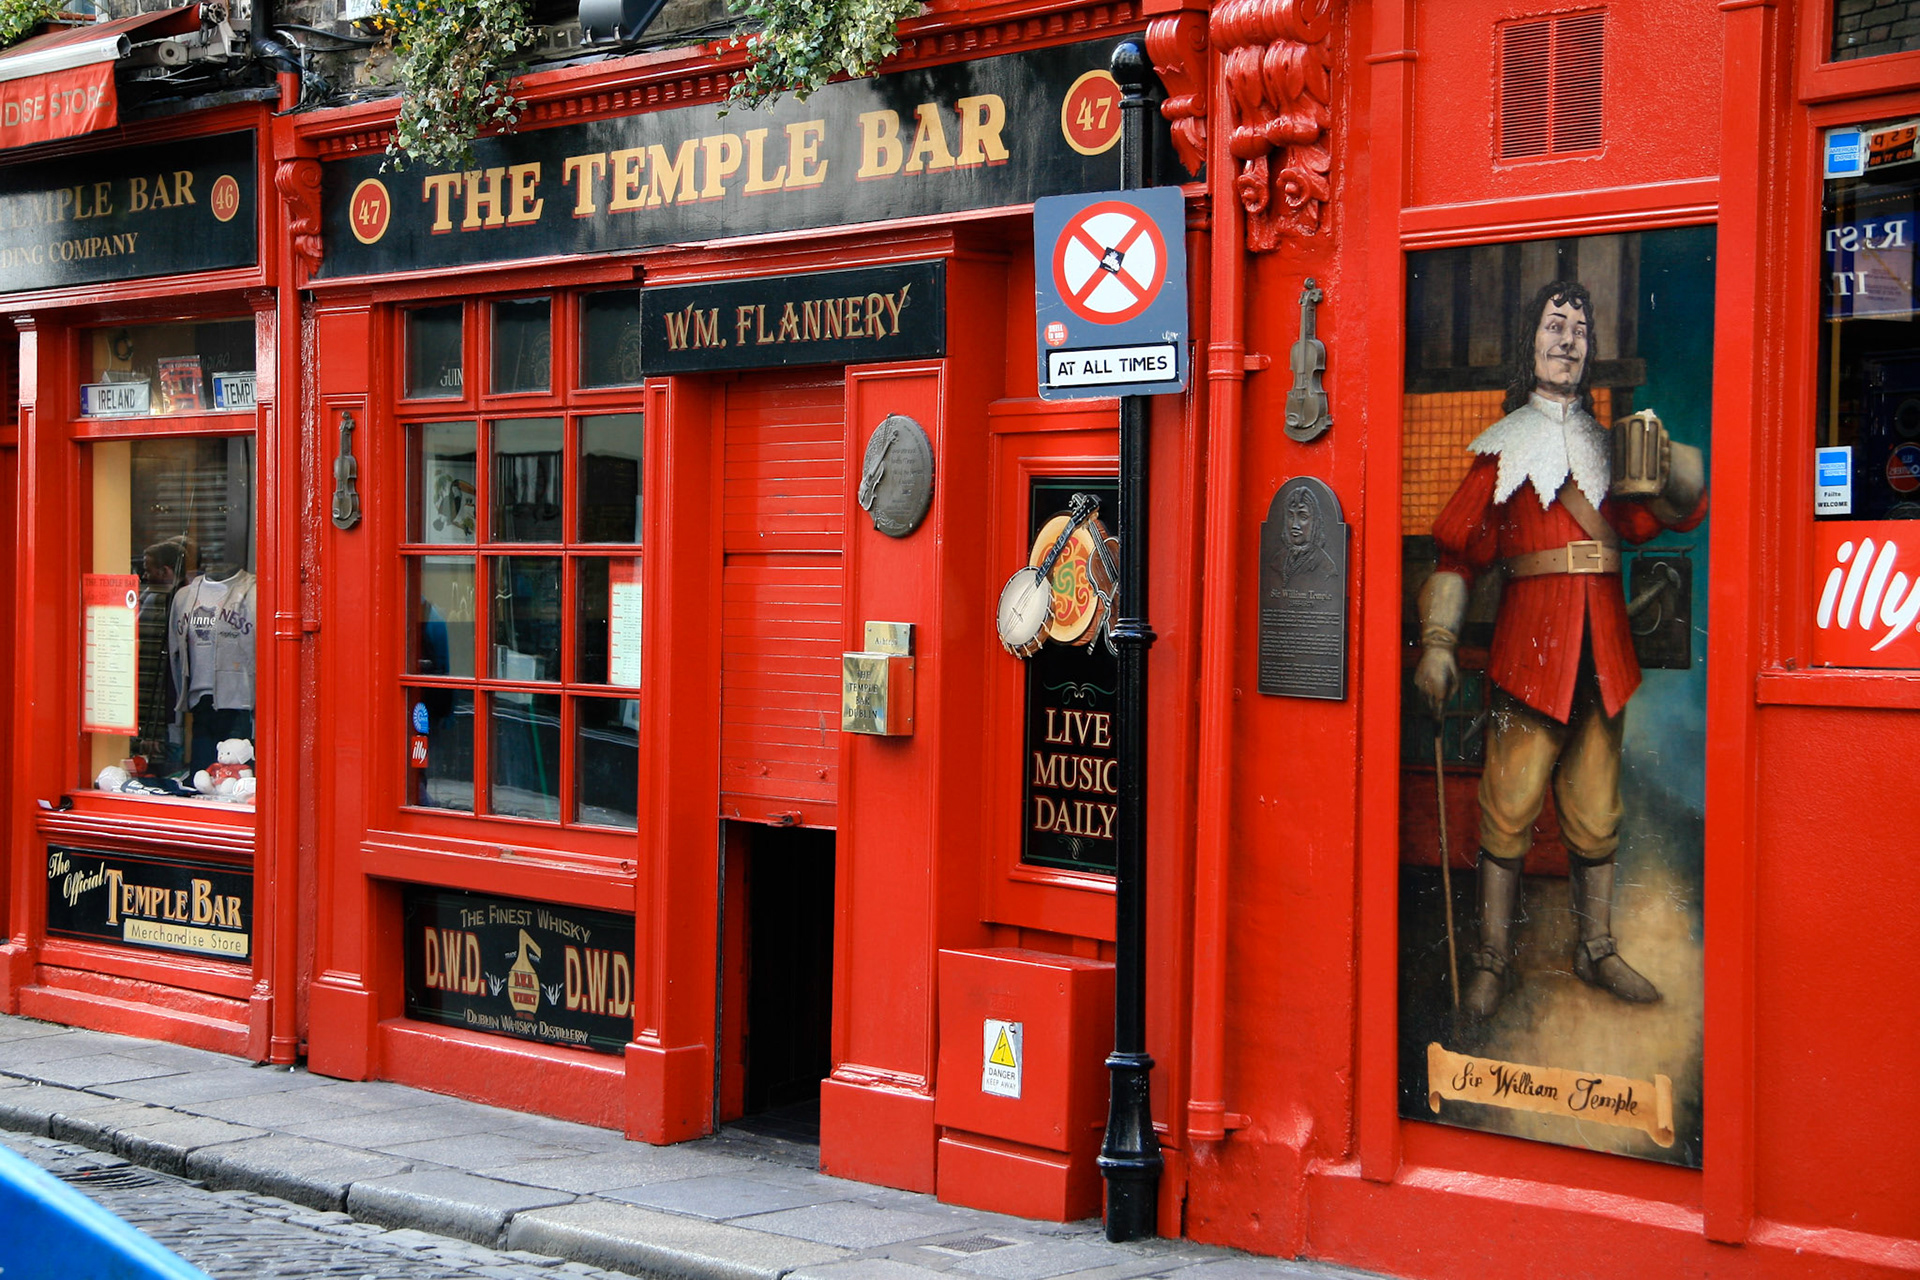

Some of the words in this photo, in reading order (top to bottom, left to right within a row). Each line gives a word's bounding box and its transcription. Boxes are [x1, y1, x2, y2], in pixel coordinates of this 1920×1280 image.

[50, 82, 111, 118] STORE
[1076, 96, 1112, 131] 47
[423, 161, 544, 235] THE
[563, 120, 829, 219] TEMPLE
[856, 93, 1009, 181] BAR
[0, 181, 114, 230] EMPLE
[129, 170, 196, 213] BAR
[215, 184, 234, 210] 46
[358, 199, 382, 225] 47
[50, 232, 139, 263] COMPANY
[664, 301, 727, 350] WM.
[736, 282, 912, 347] FLANNERY
[1057, 361, 1076, 376] AT
[1083, 359, 1113, 374] ALL
[1119, 355, 1168, 373] TIMES
[98, 388, 135, 410] IRELAND
[1816, 537, 1920, 651] illy
[849, 682, 879, 693] TEMPLE
[857, 670, 872, 680] THE
[848, 708, 878, 719] DUBLIN
[1046, 708, 1111, 747] LIVE
[412, 740, 427, 764] illy
[1032, 752, 1118, 794] MUSIC
[1034, 795, 1118, 839] DAILY
[48, 851, 71, 879] The
[63, 862, 106, 907] Official
[105, 868, 189, 926] TEMPLE
[191, 878, 243, 929] BAR
[131, 923, 205, 948] Merchandise
[211, 933, 242, 952] Store
[460, 908, 486, 928] THE
[489, 904, 532, 926] FINEST
[536, 908, 592, 944] WHISKY
[424, 926, 487, 997] D.W.D.
[466, 1009, 499, 1030] DUBLIN
[500, 1015, 538, 1036] WHISKY
[986, 1078, 999, 1087] KEEP
[1000, 1081, 1017, 1090] AWAY
[988, 1067, 1016, 1081] DANGER
[1452, 1061, 1483, 1091] Sir
[1489, 1064, 1558, 1101] William
[1568, 1078, 1639, 1116] Temple
